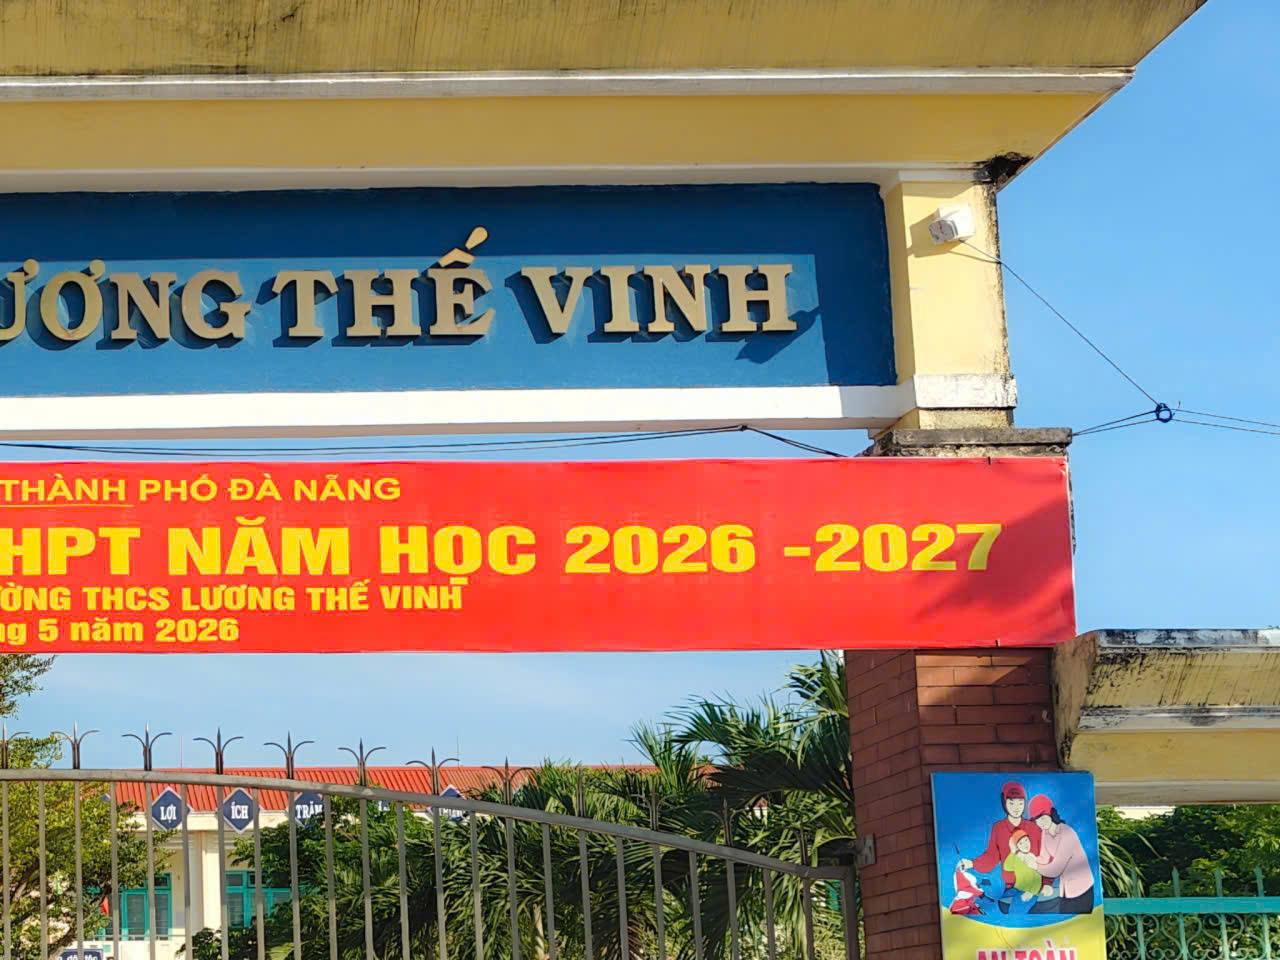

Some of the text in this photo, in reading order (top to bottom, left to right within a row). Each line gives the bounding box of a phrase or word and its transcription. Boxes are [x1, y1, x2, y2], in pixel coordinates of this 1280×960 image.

[272, 226, 494, 337] THẾ
[521, 263, 797, 336] VINH
[0, 474, 125, 500] THÀNH
[140, 473, 217, 501] PHỐ
[228, 473, 282, 501] ĐÀ
[169, 516, 349, 575] NĂM
[381, 526, 535, 584] HỌC
[565, 525, 755, 573] 2026
[83, 587, 169, 610] THCS
[183, 585, 294, 610] LƯƠNG
[307, 580, 369, 610] THẾ
[383, 586, 461, 609] VINH
[39, 619, 57, 641] 5
[71, 618, 143, 640] năm
[156, 619, 238, 641] 2026
[160, 805, 177, 824] LỢI
[231, 802, 249, 820] ÍCH
